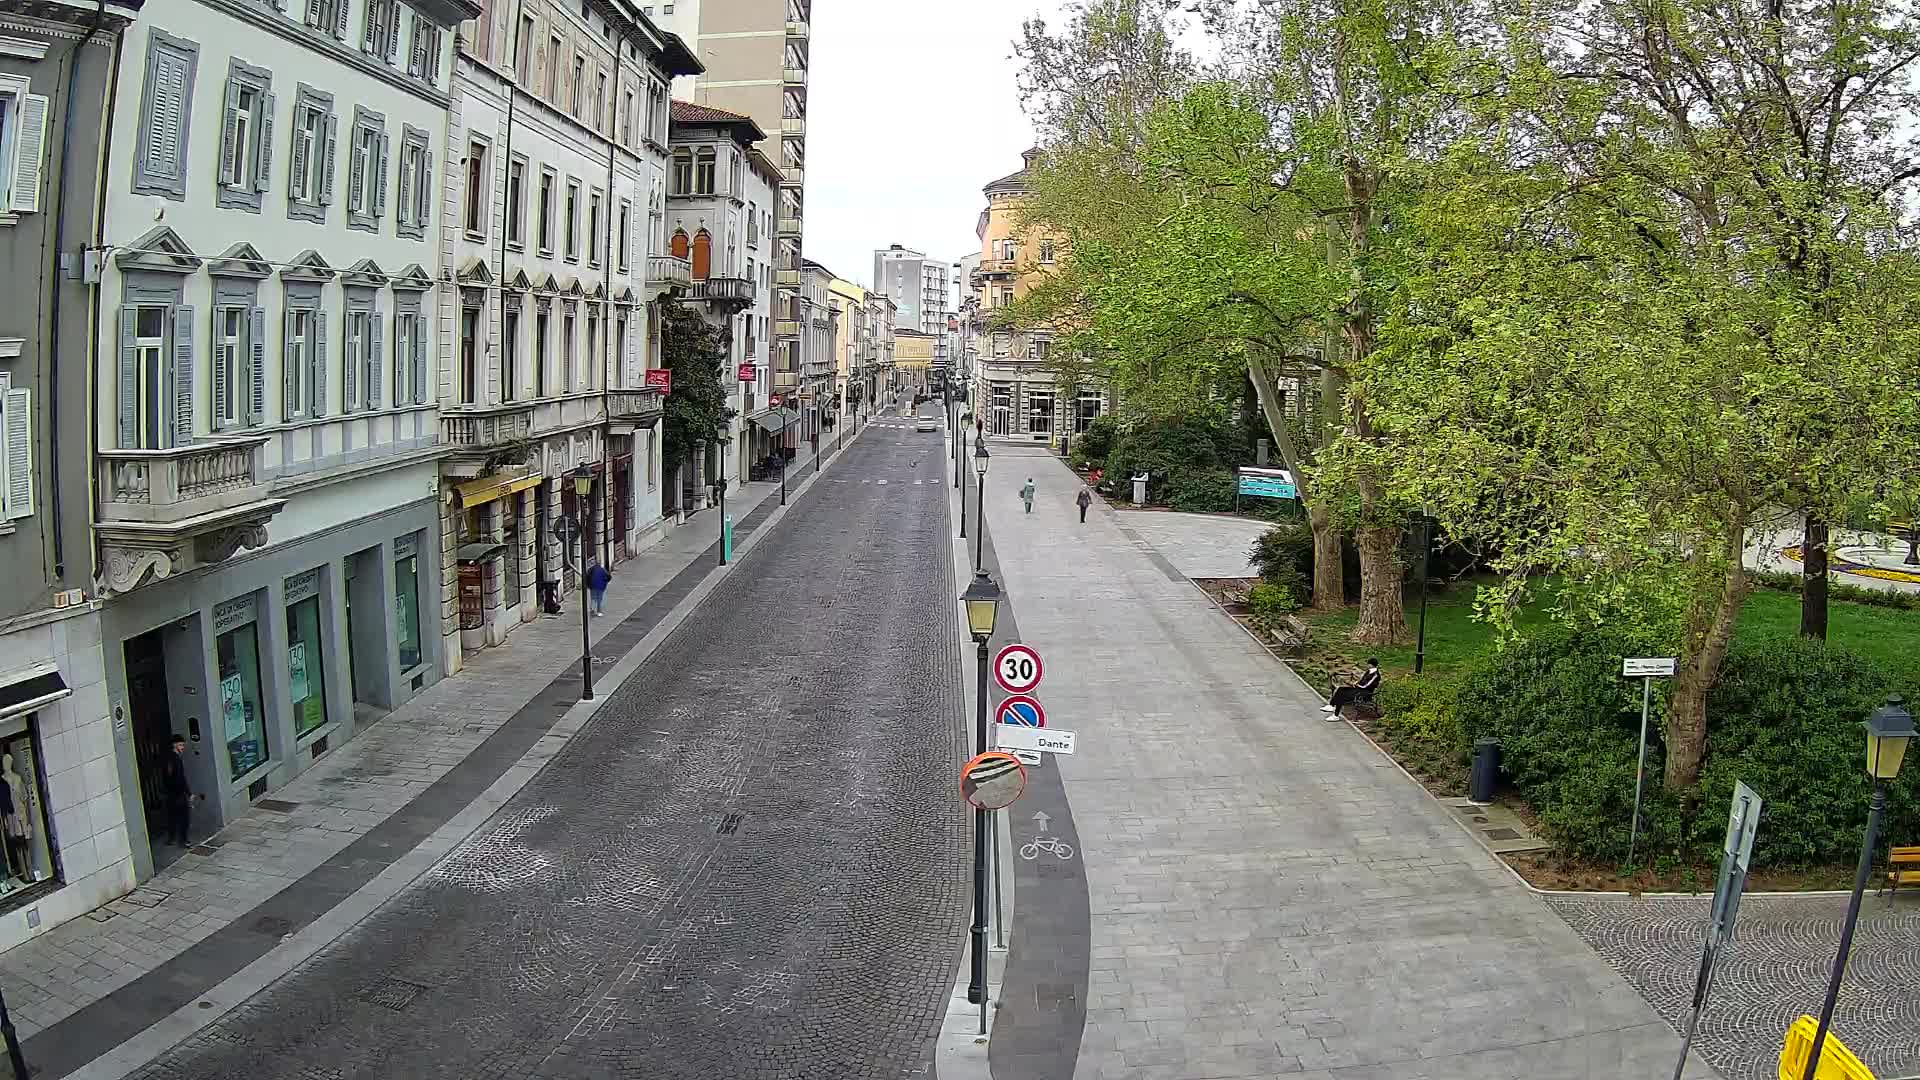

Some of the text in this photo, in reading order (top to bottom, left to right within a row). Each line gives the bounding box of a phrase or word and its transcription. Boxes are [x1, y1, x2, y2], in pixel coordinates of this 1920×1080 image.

[1005, 659, 1033, 680] 30
[222, 677, 241, 701] 130
[1038, 738, 1070, 749] Dante
